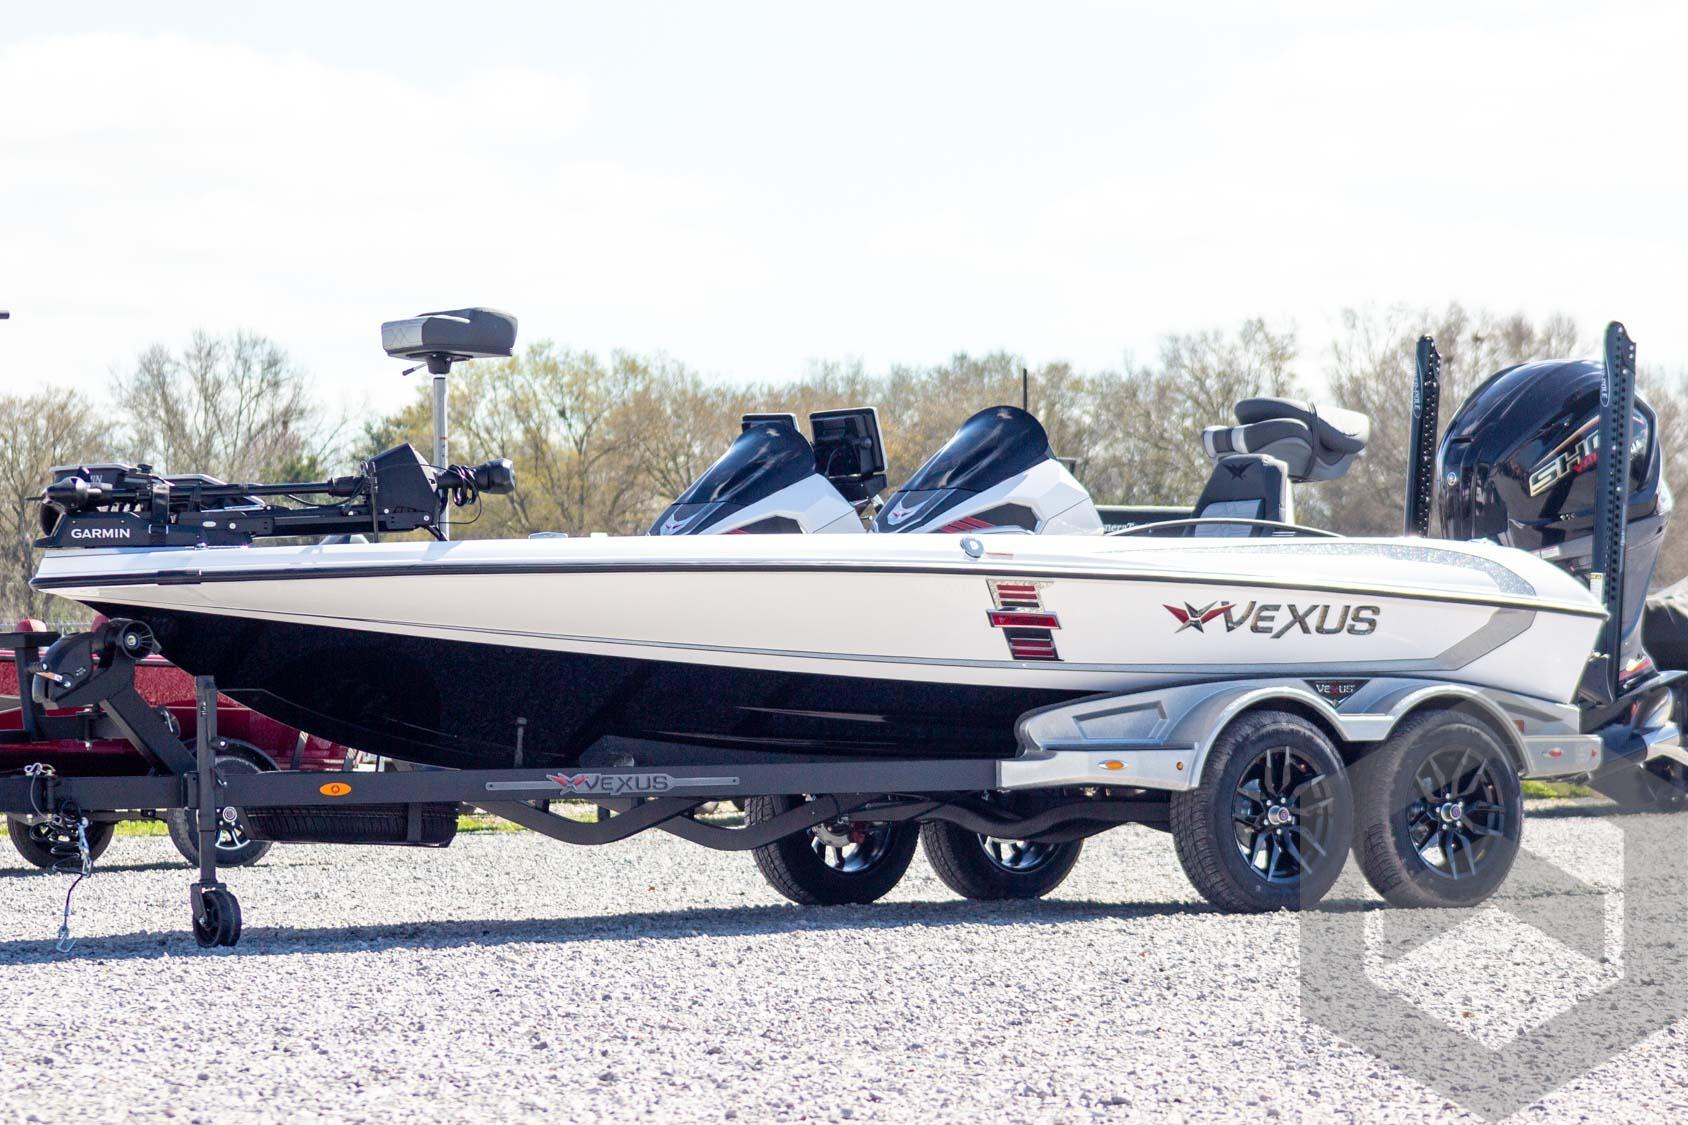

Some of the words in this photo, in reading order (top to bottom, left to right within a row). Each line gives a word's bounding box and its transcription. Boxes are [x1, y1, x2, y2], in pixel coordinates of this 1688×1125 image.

[71, 528, 131, 539] GARMIN
[1220, 600, 1381, 638] VEXUS
[1315, 683, 1356, 695] VEXUS
[585, 775, 669, 793] VEXUS
